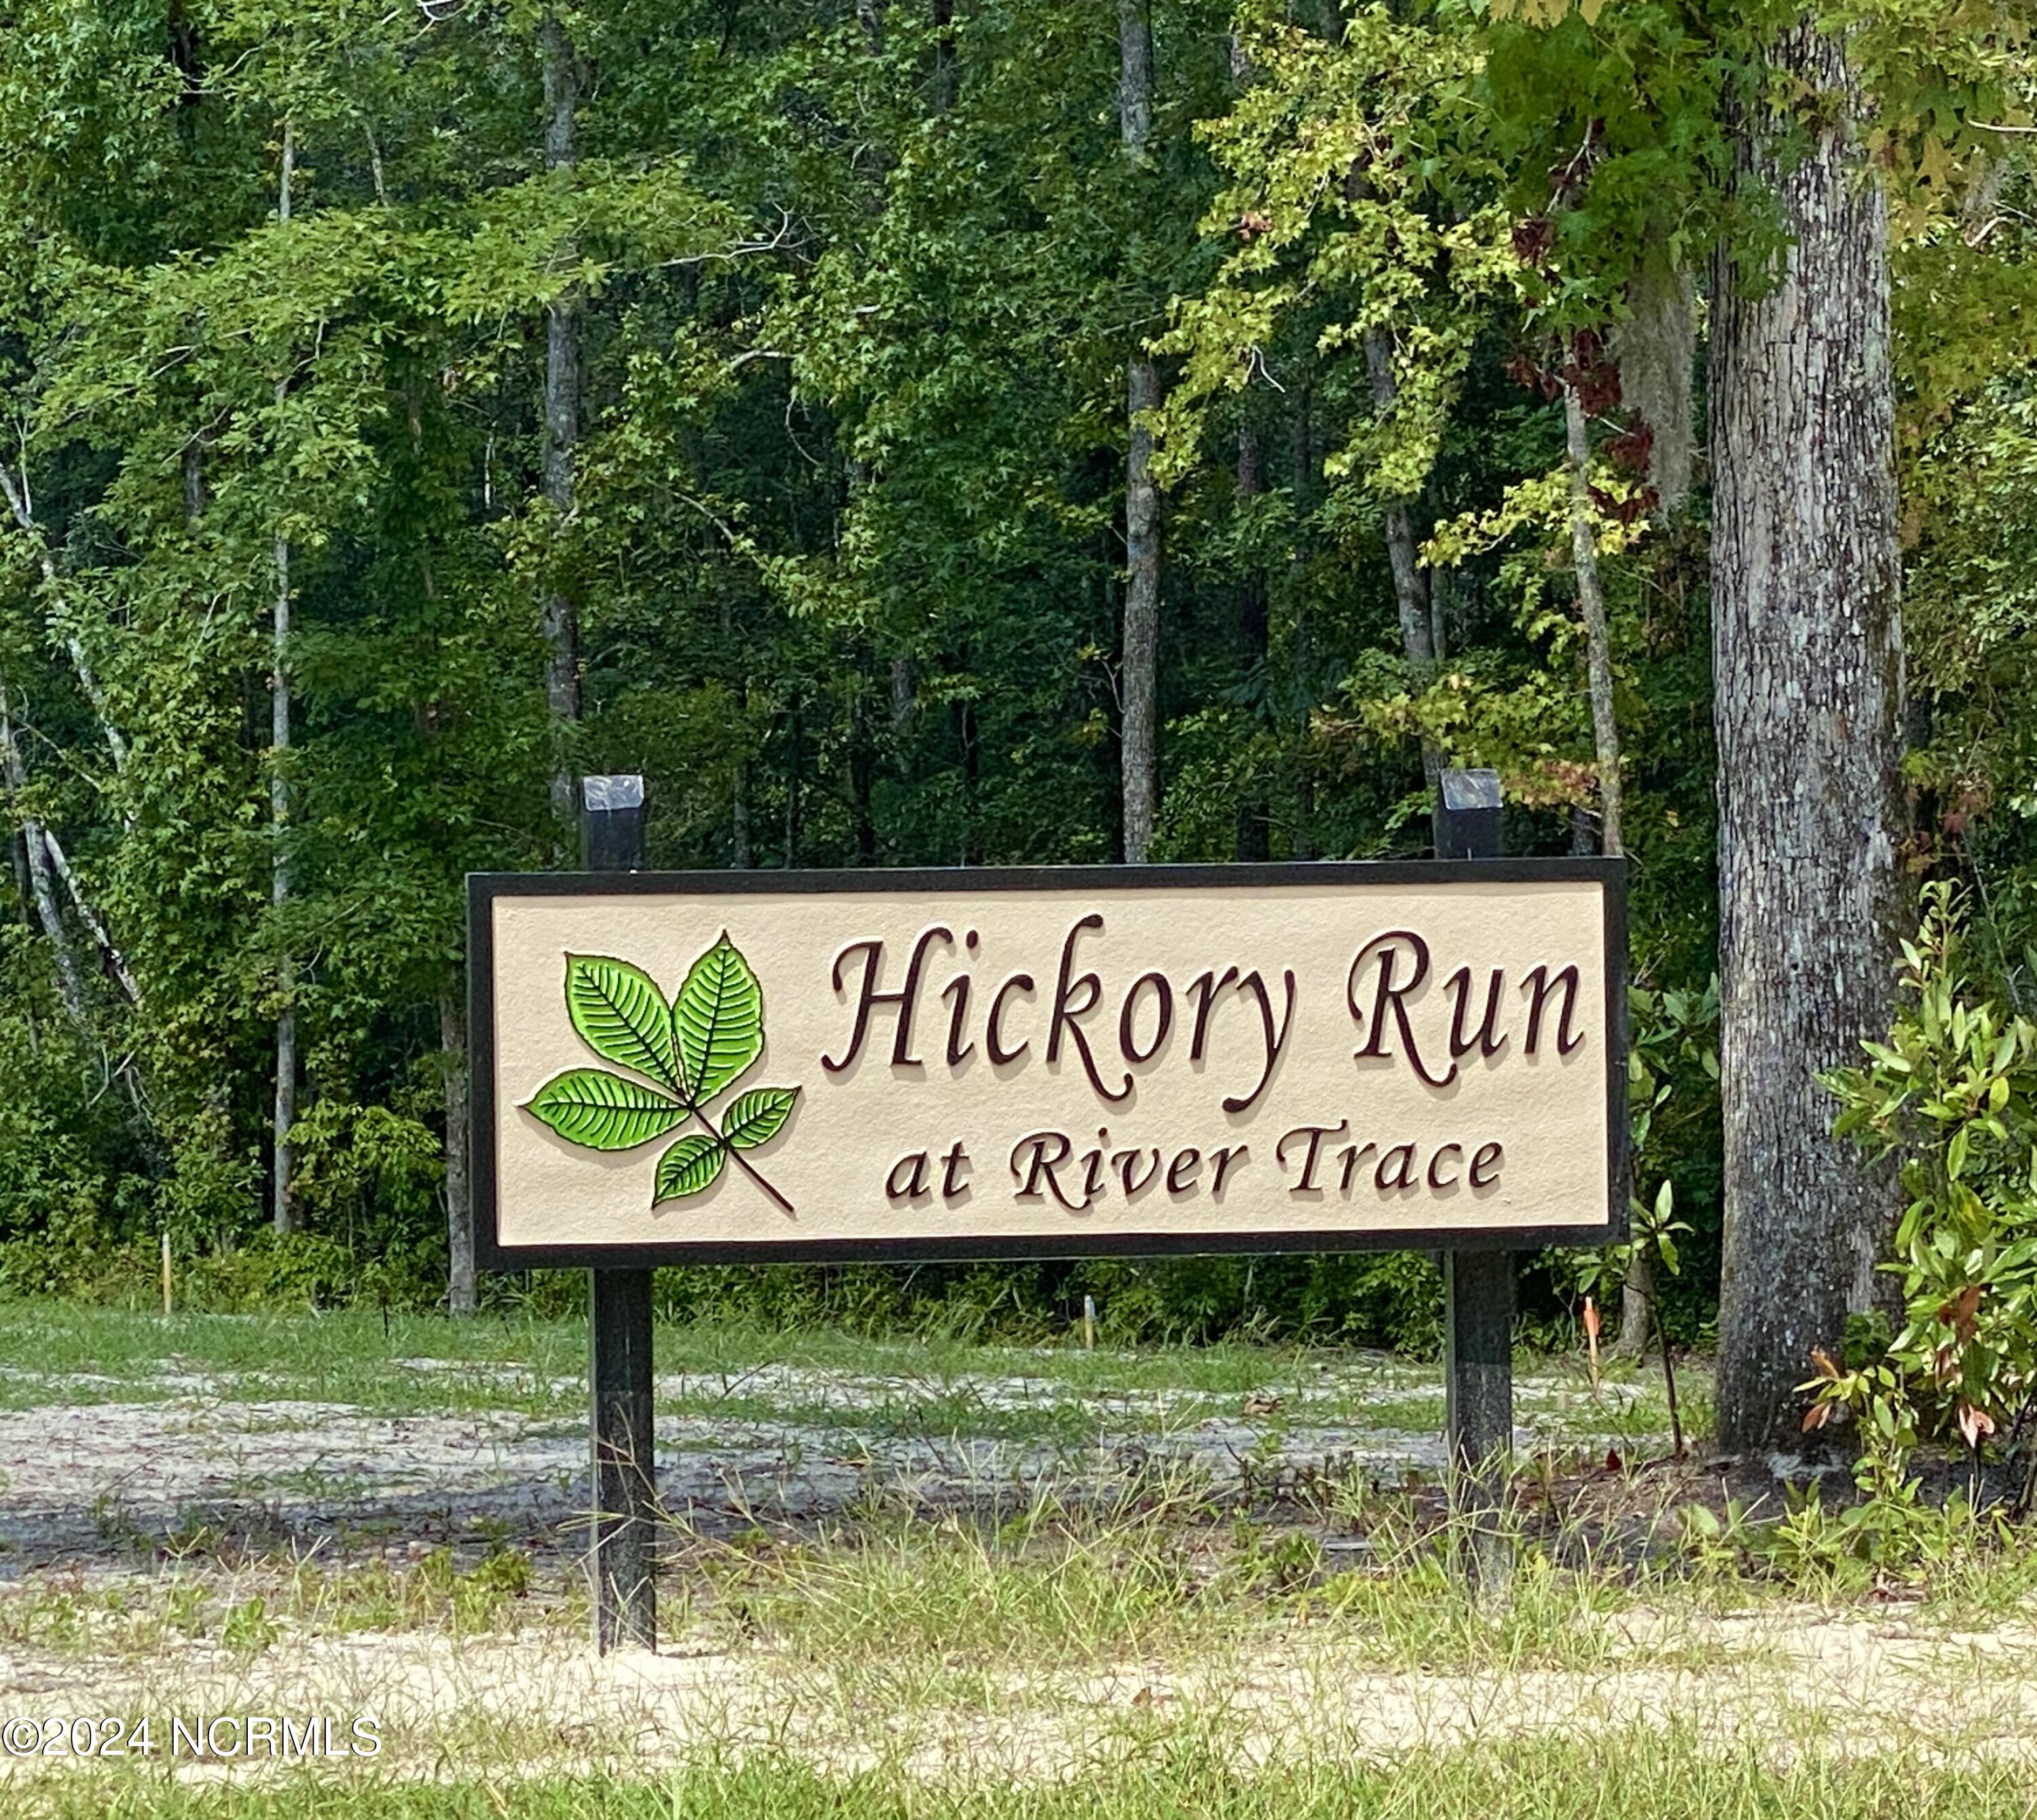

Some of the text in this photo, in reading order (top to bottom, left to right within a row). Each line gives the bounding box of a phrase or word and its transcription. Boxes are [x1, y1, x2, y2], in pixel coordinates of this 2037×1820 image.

[821, 914, 1585, 1114] Hickory Run
[885, 1119, 1503, 1211] at River Trace
